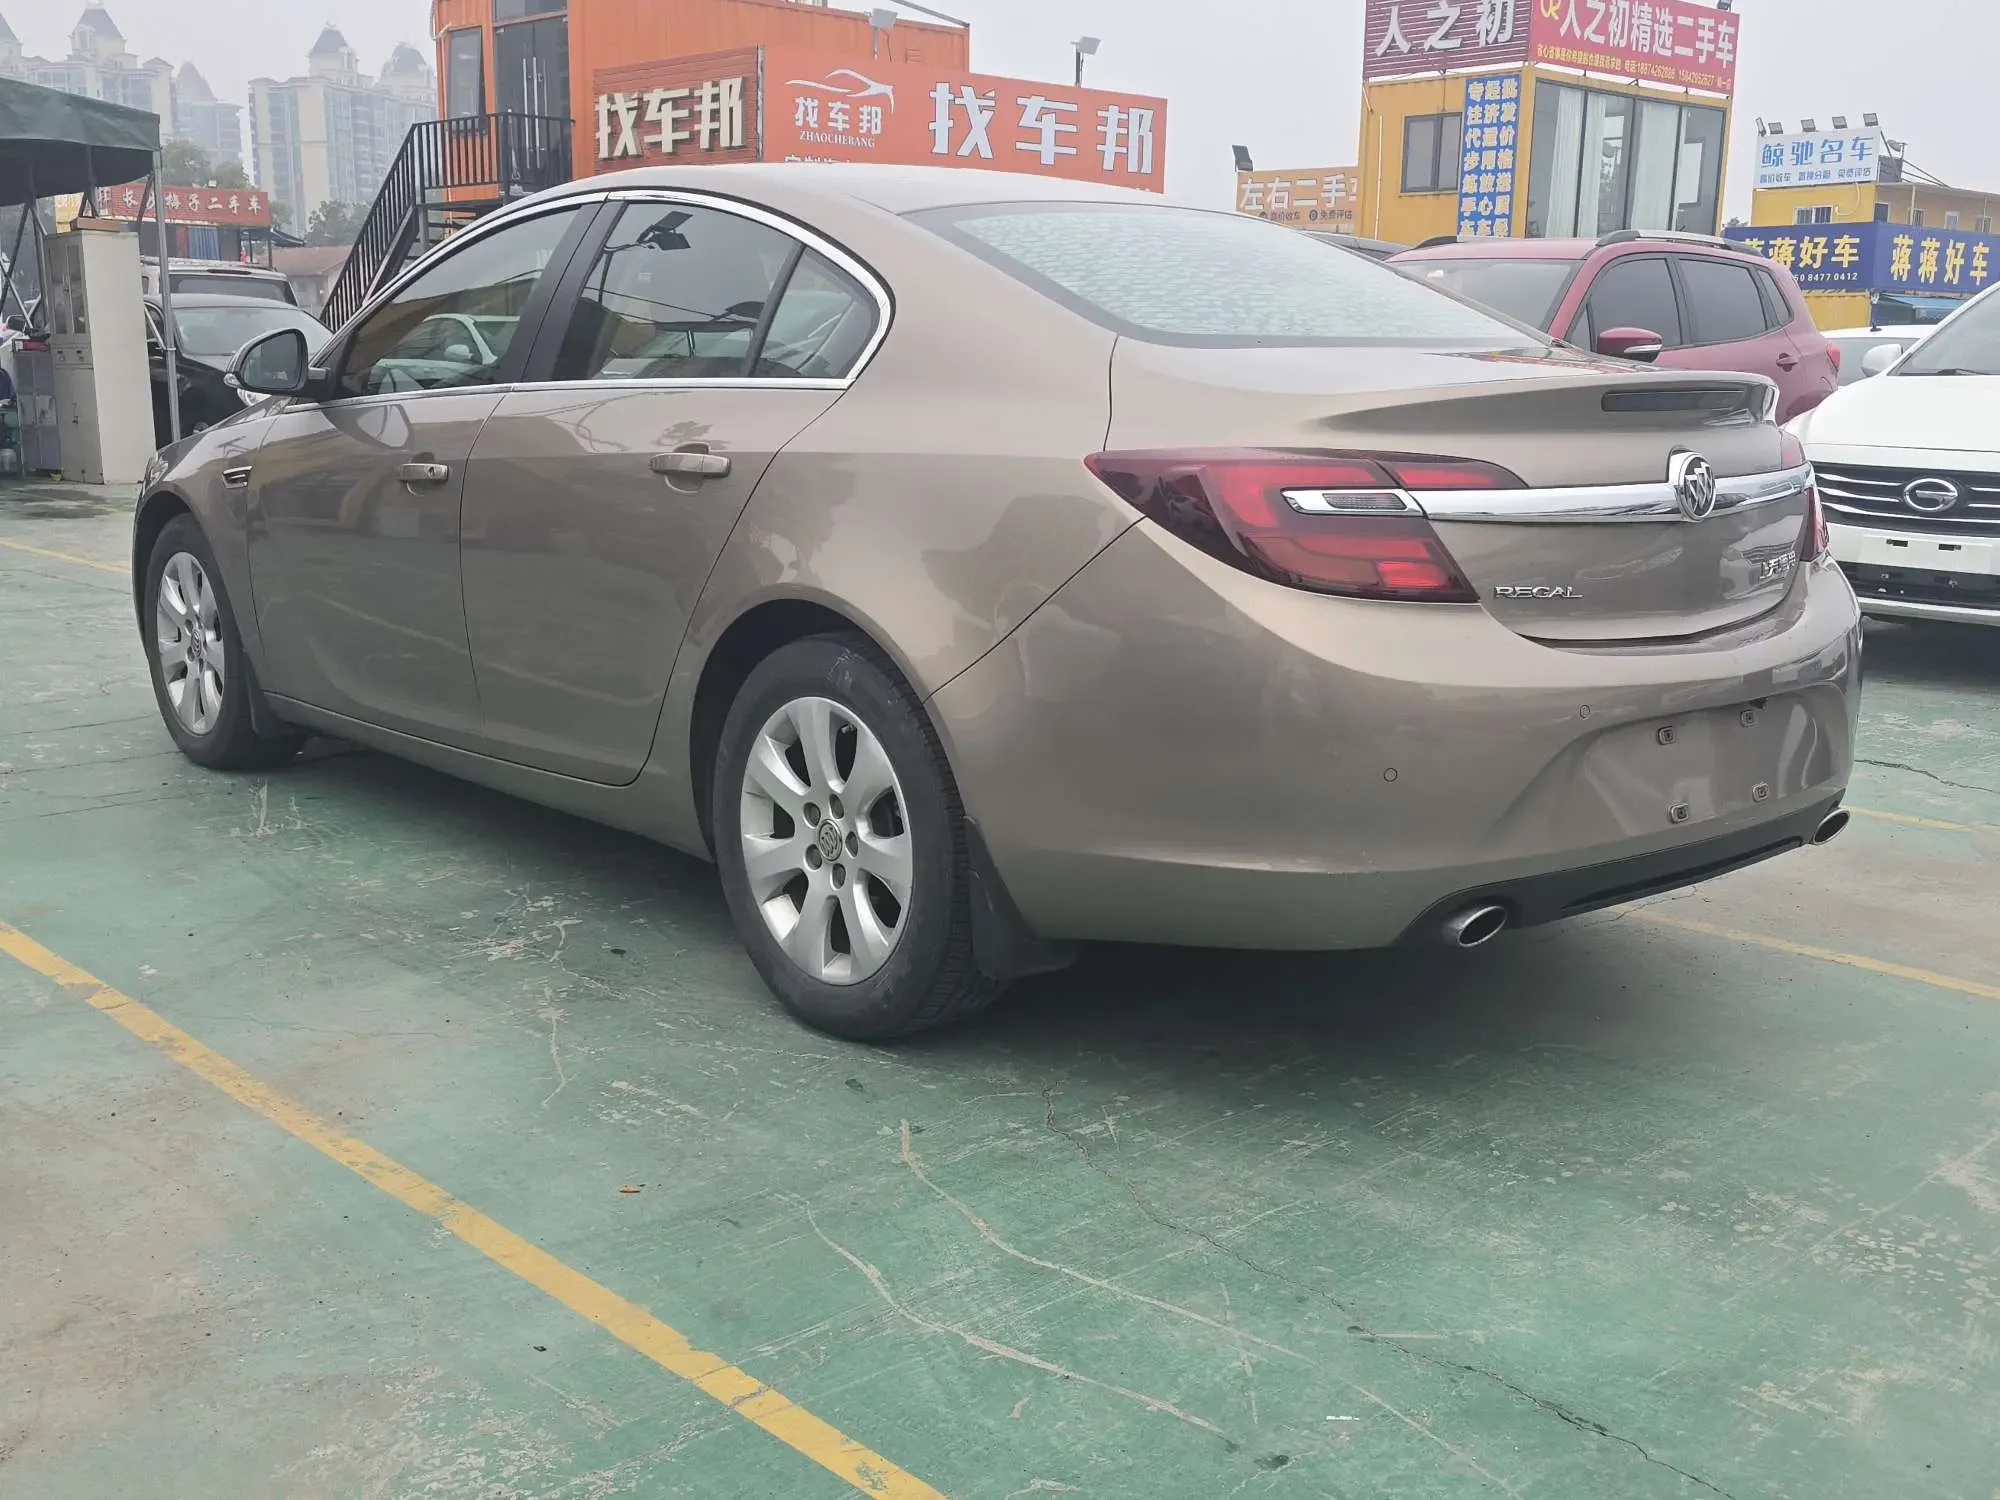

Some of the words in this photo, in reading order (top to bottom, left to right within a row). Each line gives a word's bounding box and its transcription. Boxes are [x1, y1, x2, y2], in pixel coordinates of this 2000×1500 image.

[1375, 0, 1515, 57] 人之初
[1559, 0, 1736, 69] 人之初精选二手车
[596, 76, 745, 160] 找车邦
[793, 96, 882, 135] 找车邦
[799, 130, 876, 148] ZHAOCHEBANG
[928, 81, 1154, 175] 找车邦
[1760, 136, 1874, 169] 鲸驰名车
[1891, 233, 1990, 286] 蒋蒋好车
[1494, 585, 1585, 599] REGAL
